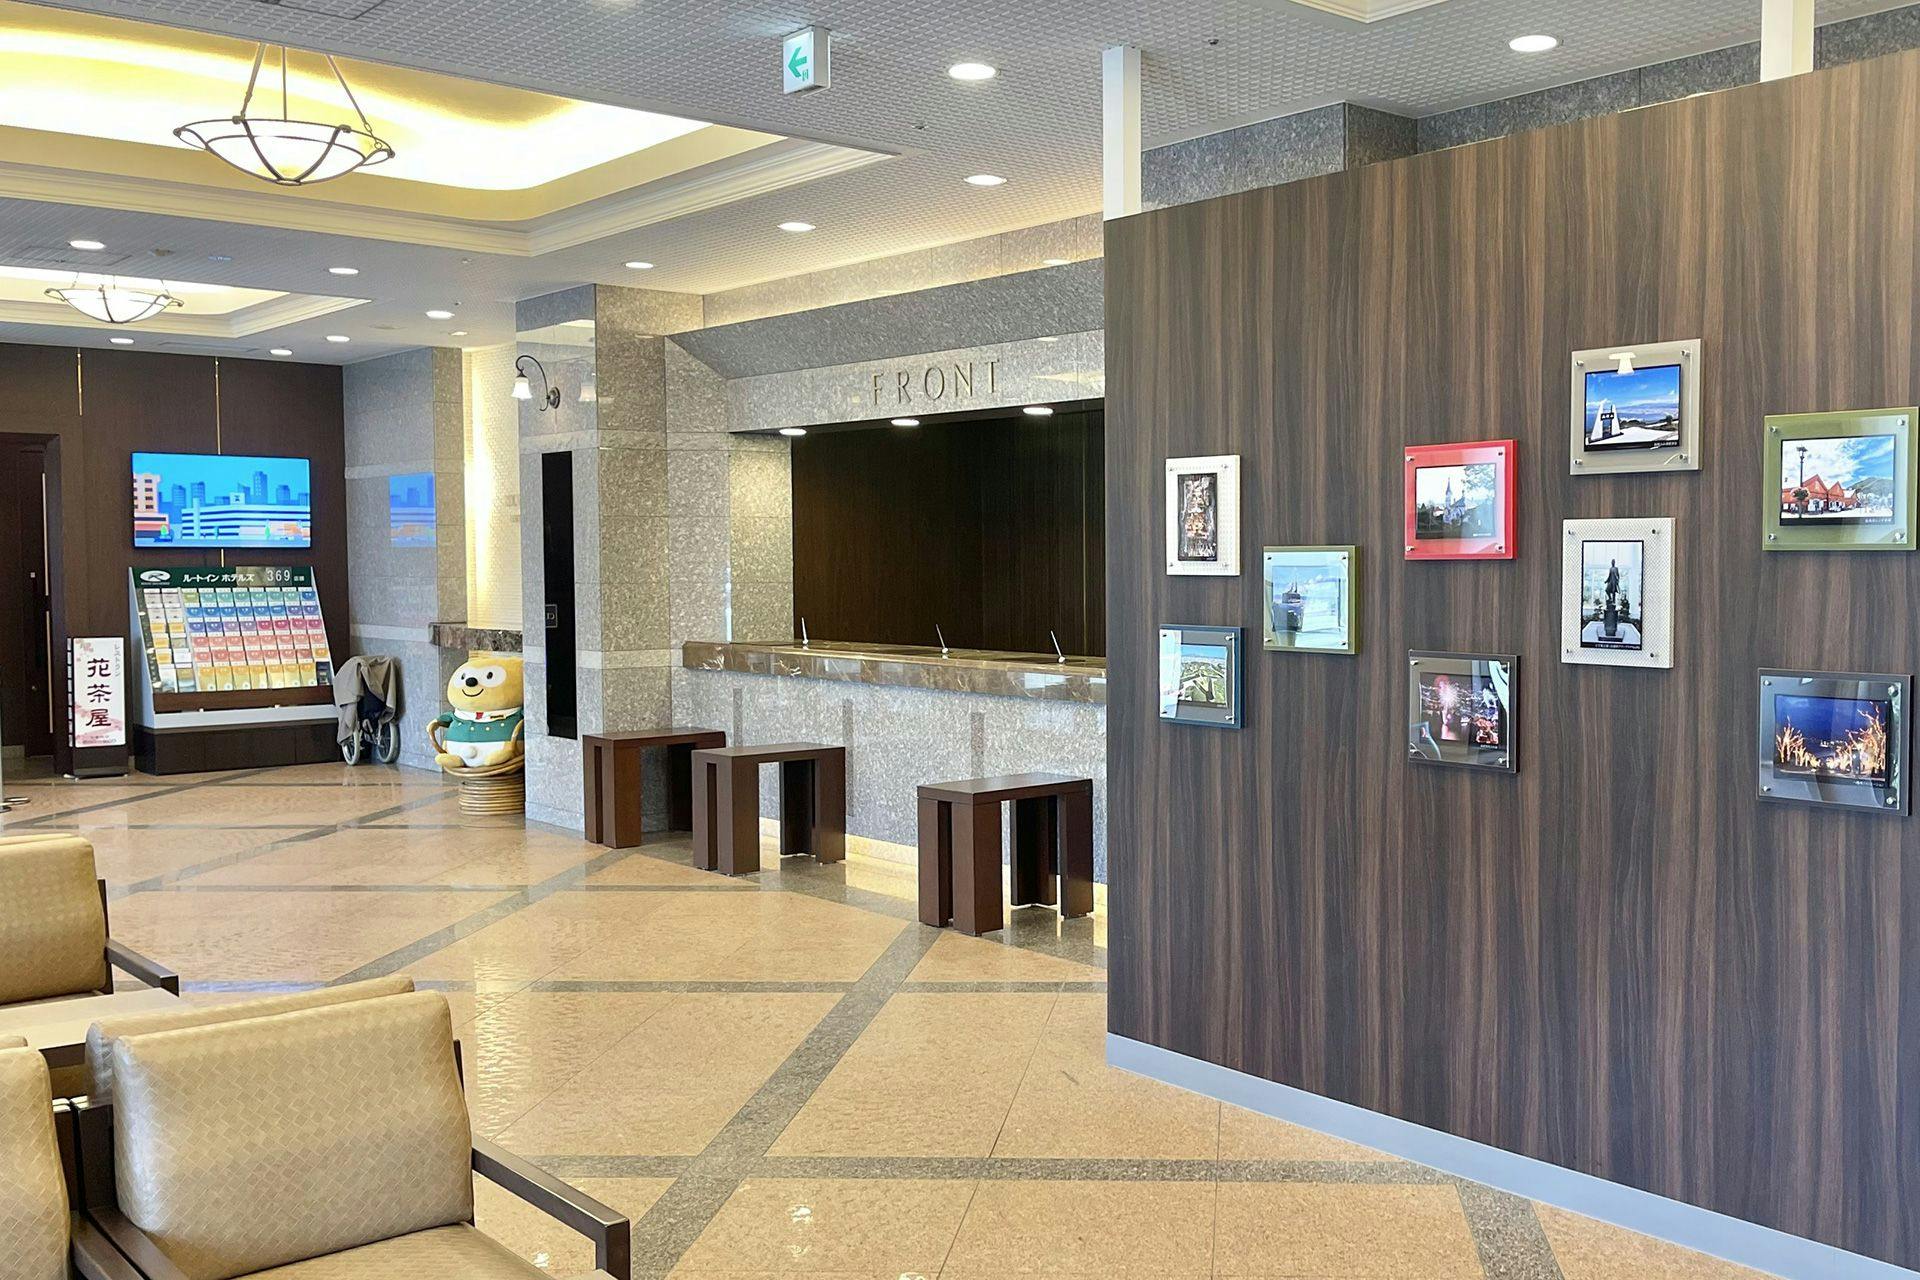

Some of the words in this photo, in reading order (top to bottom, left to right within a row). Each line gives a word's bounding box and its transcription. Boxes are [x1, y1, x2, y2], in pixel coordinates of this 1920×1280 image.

[872, 359, 1000, 405] FRONT
[182, 573, 220, 583] ルートイン
[267, 569, 290, 582] 369
[85, 658, 112, 727] 花茶屋
